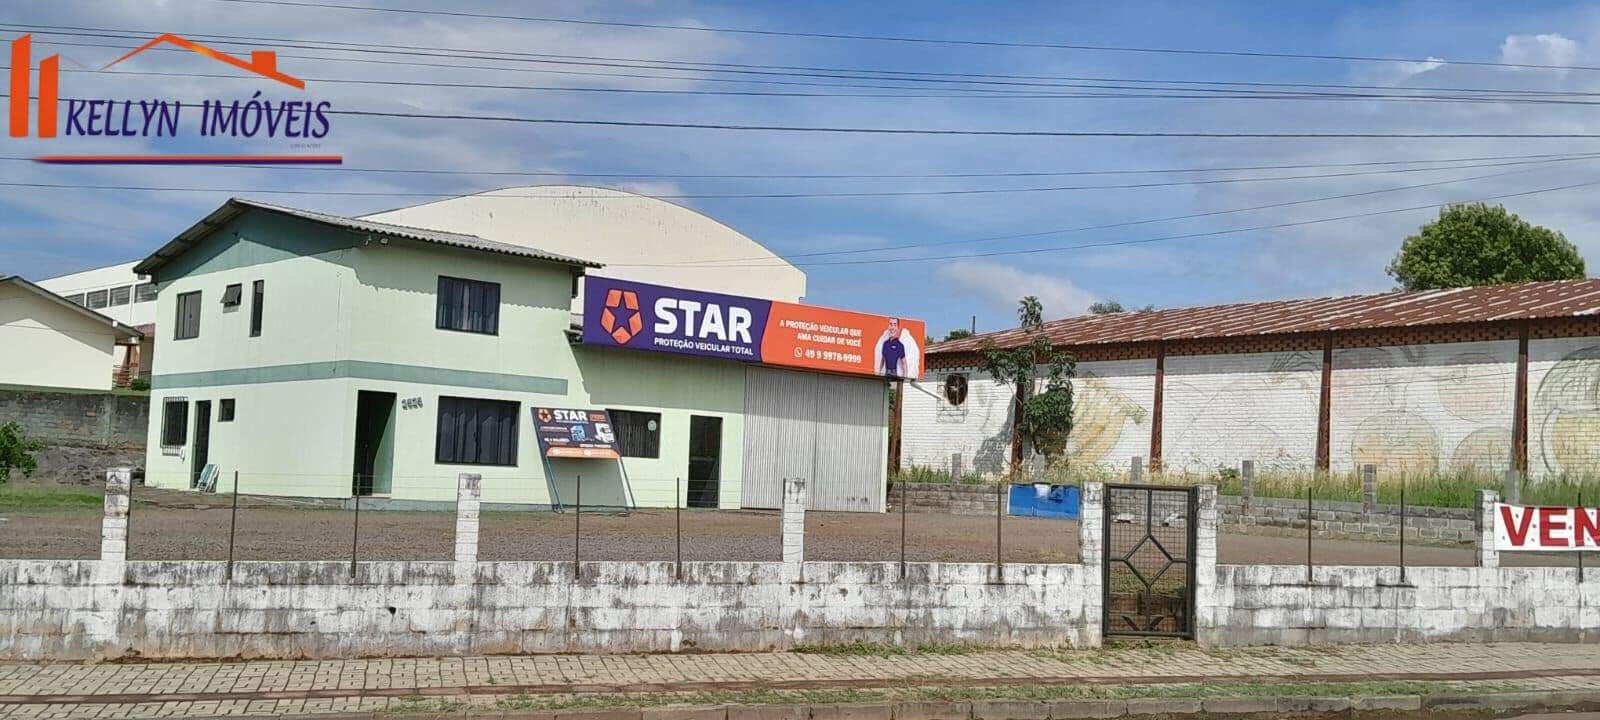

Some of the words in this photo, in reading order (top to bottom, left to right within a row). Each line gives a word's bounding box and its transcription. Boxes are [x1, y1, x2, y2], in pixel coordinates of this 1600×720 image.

[654, 297, 752, 343] STAR
[779, 319, 785, 327] A
[785, 320, 818, 332] PROTEÇÃO
[819, 324, 849, 335] VEICULAR
[849, 328, 862, 337] QUE
[654, 337, 694, 349] PROTEÇÃO
[695, 342, 730, 353] VEICULAR
[731, 346, 754, 356] TOTAL
[797, 332, 812, 341] AMA
[812, 334, 836, 344] CUIDAR
[836, 337, 846, 345] DE
[846, 337, 861, 347] VOCÊ
[805, 349, 815, 358] 49
[816, 350, 822, 359] 9
[553, 409, 588, 421] STAR
[1500, 506, 1600, 546] VEN
